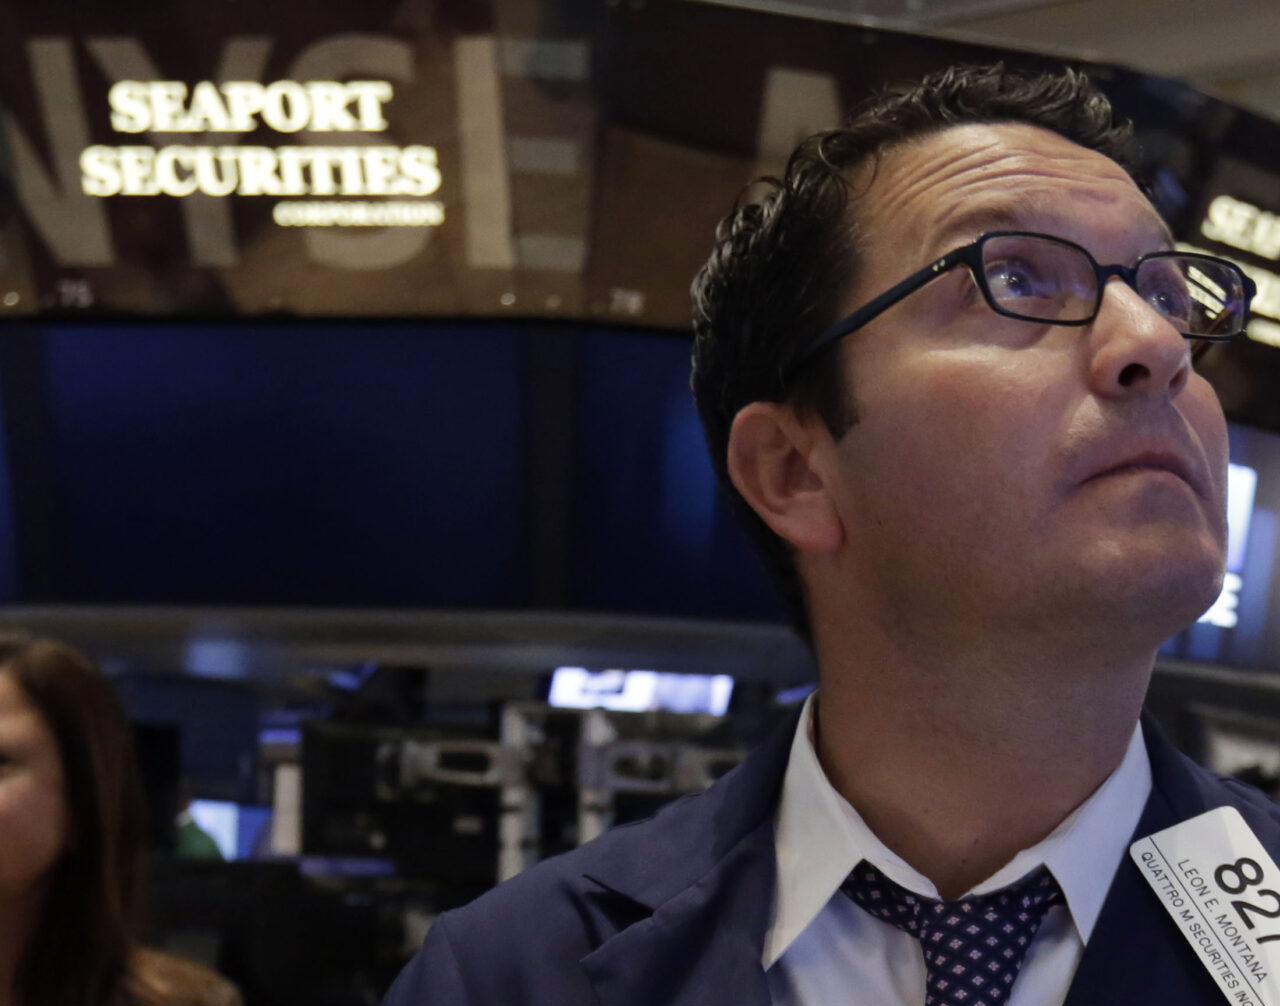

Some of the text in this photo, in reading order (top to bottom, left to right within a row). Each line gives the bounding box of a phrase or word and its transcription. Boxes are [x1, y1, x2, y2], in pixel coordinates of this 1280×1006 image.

[109, 80, 393, 133] SEAPORT
[80, 145, 442, 196] SECURITIES
[1141, 852, 1184, 908] QUATTRO
[1179, 909, 1193, 922] M
[1189, 923, 1240, 989] SECURITIES
[1178, 859, 1267, 984] LEON E. MONTANA
